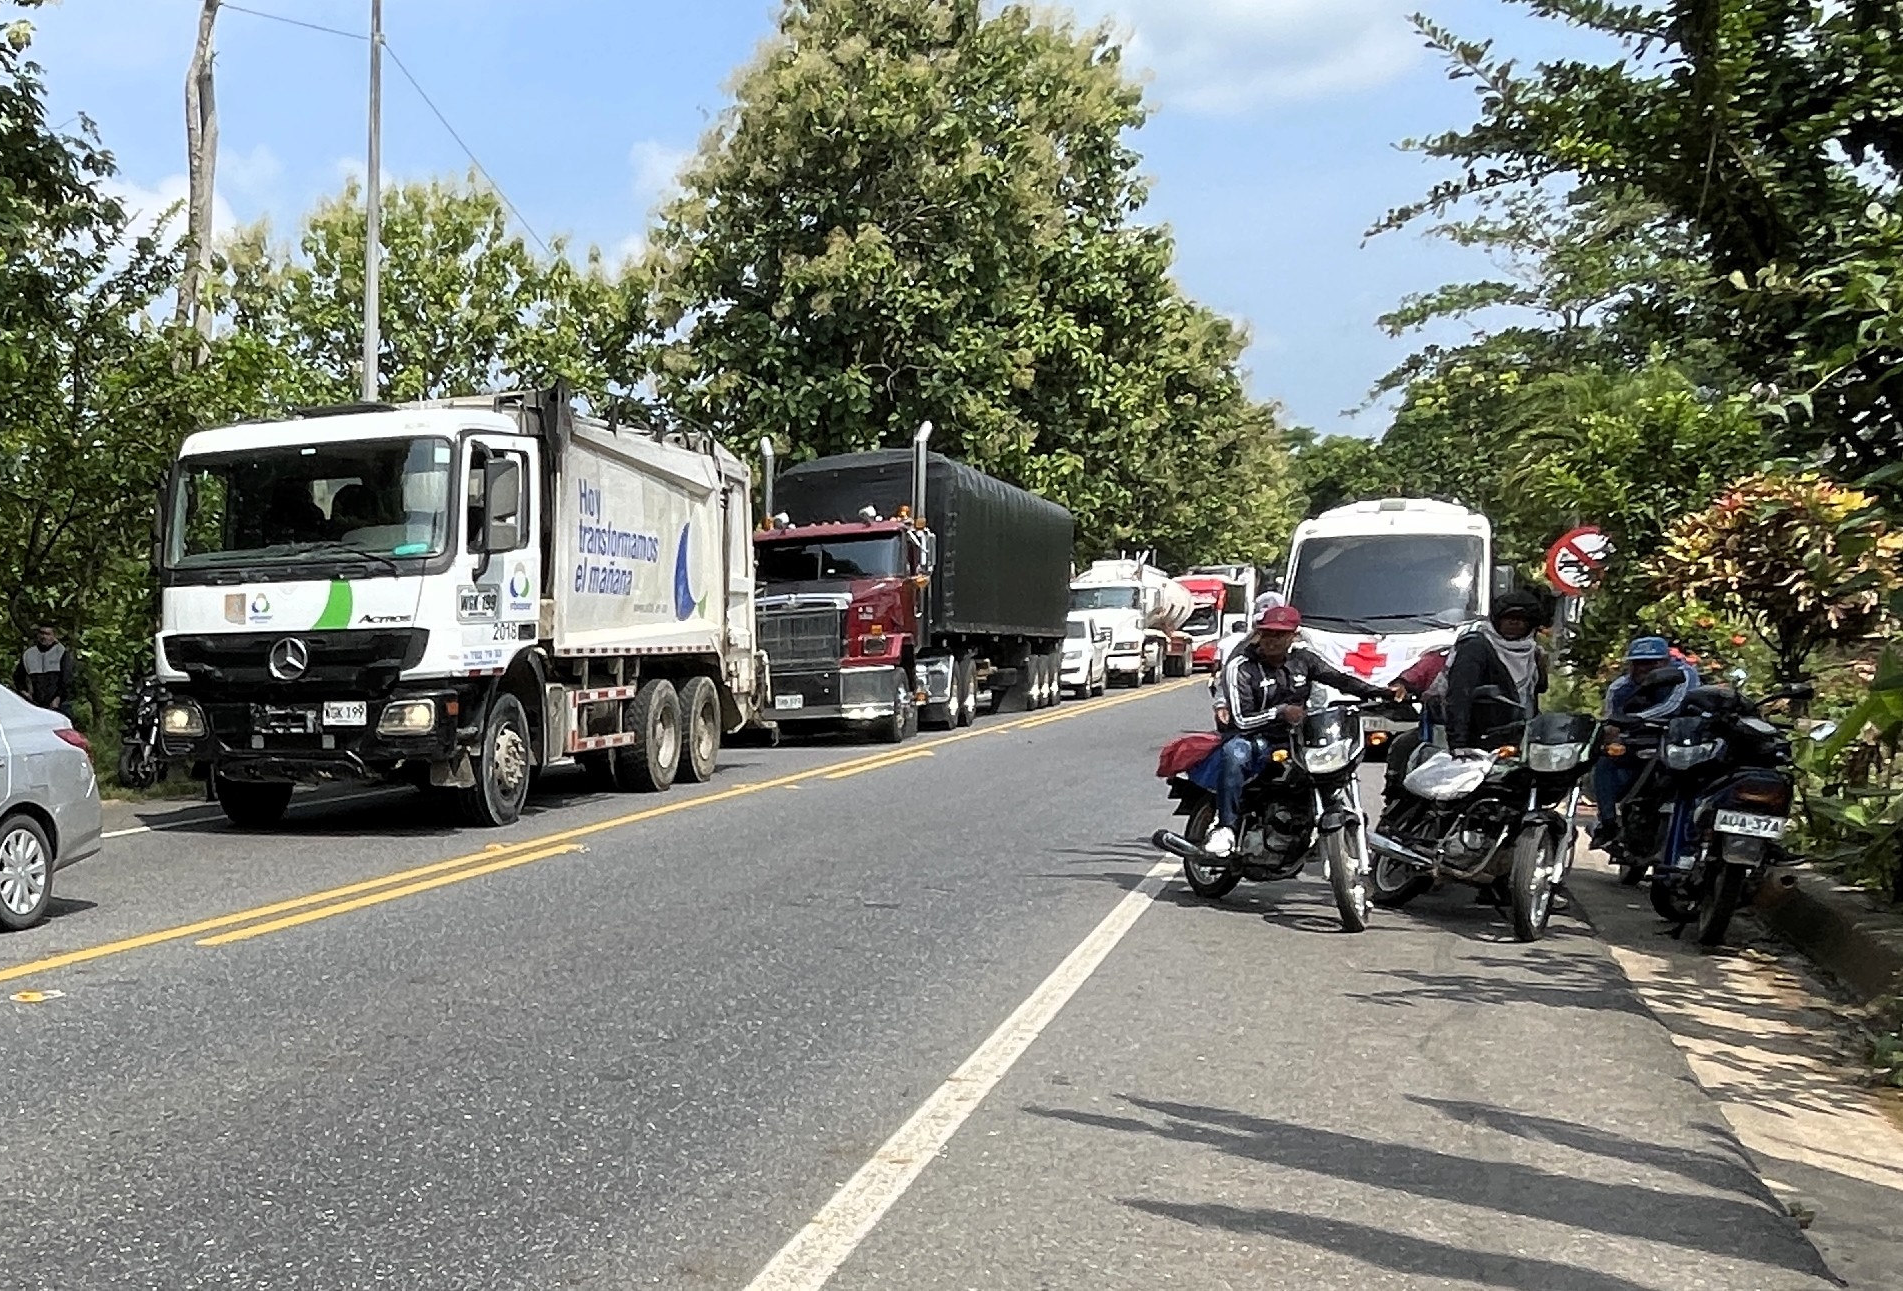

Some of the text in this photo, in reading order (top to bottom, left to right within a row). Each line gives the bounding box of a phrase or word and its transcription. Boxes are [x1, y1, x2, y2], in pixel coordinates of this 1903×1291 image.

[578, 478, 601, 524] Hoy
[579, 518, 659, 563] transformamos
[575, 557, 633, 596] el mañana
[346, 705, 365, 719] 199
